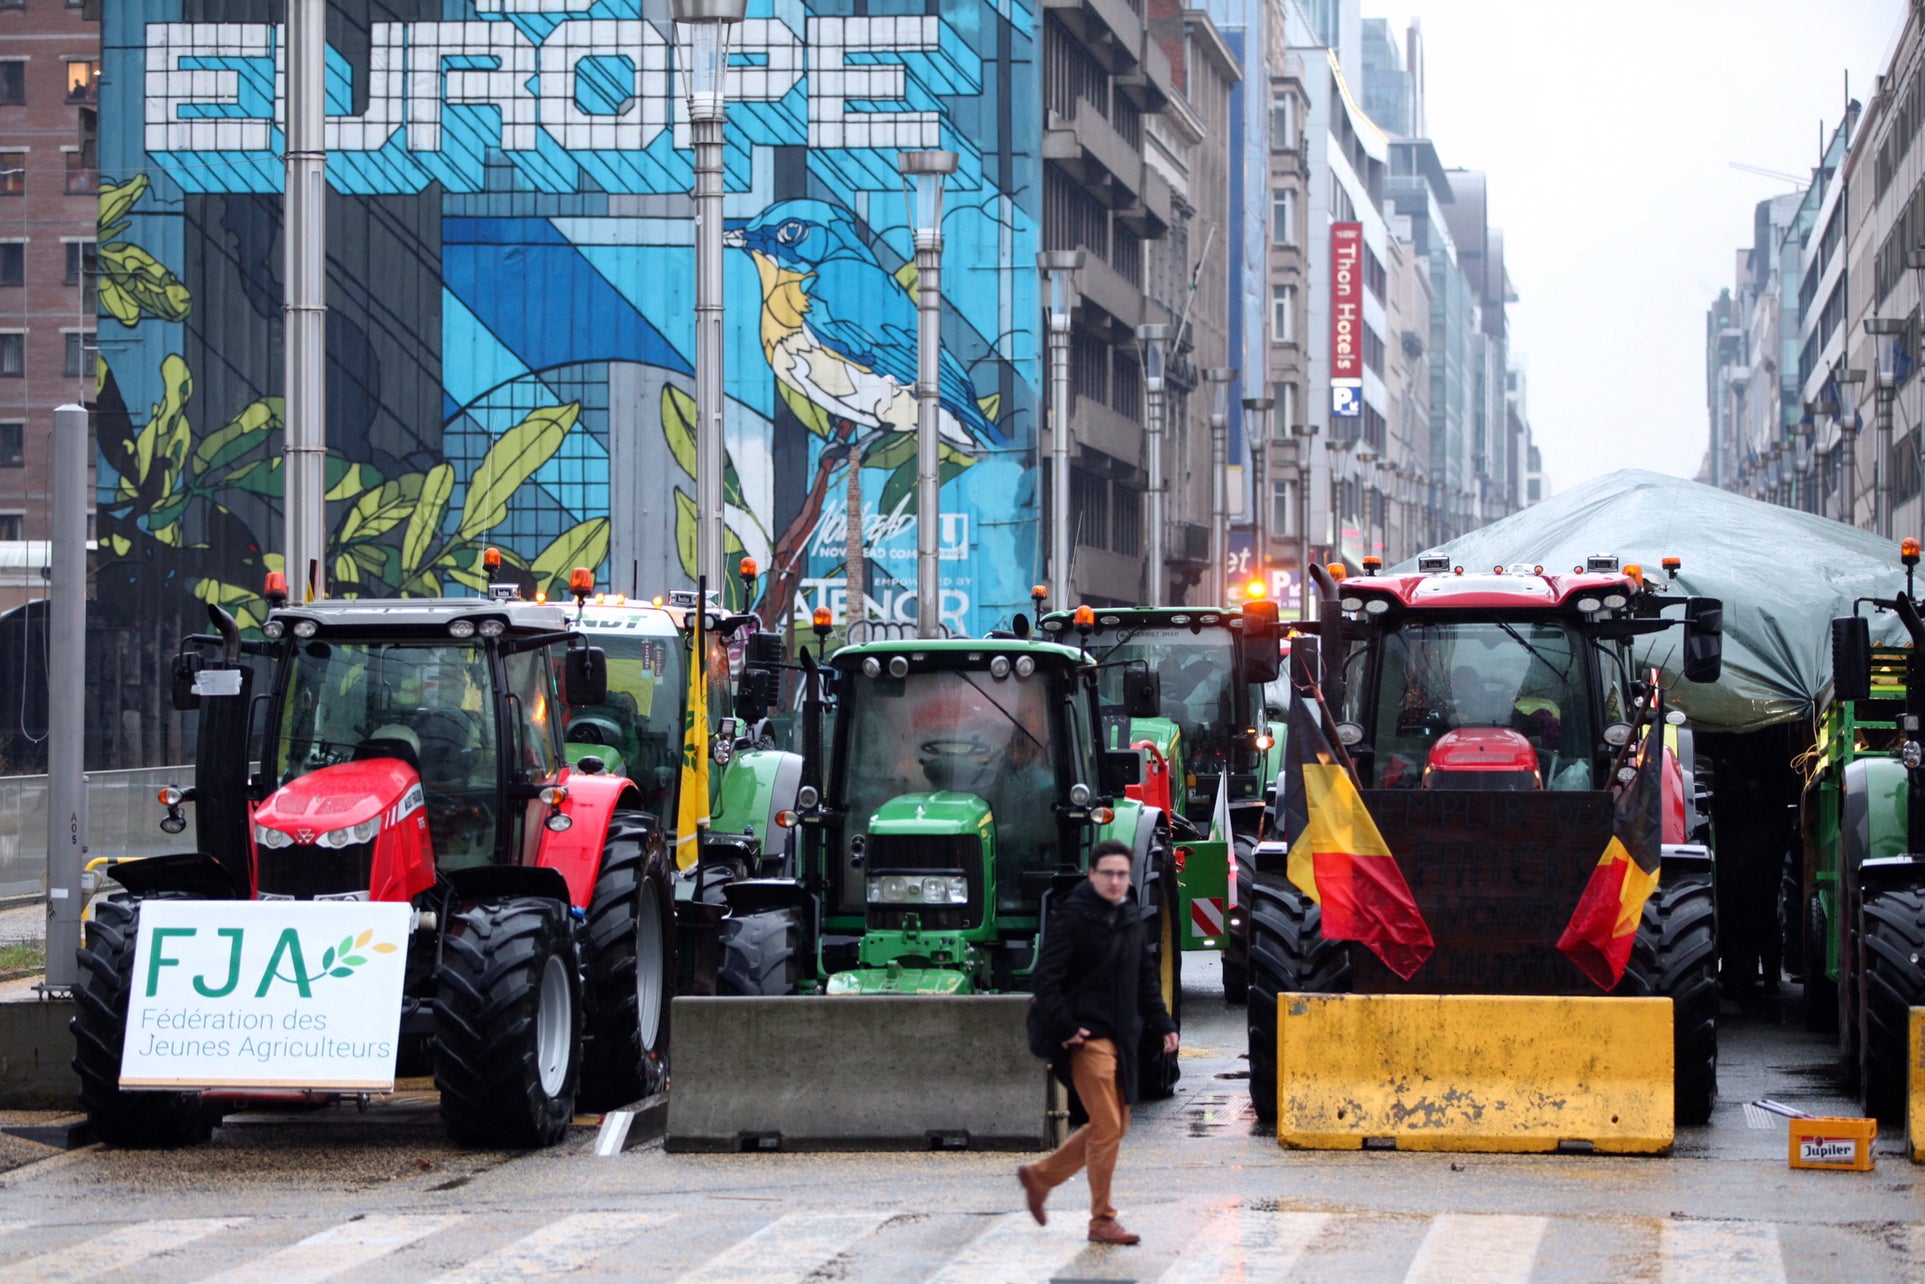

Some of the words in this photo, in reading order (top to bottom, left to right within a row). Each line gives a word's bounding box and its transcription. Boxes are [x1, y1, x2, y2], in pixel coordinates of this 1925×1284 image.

[146, 15, 940, 152] EUROPE
[1337, 243, 1357, 297] Thon
[1337, 303, 1357, 370] Hotels
[145, 927, 312, 998] FJA
[141, 1008, 273, 1031] Fédération
[282, 1008, 327, 1031] des
[138, 1035, 231, 1057] Jeunes
[237, 1035, 391, 1063] Agriculteurs
[1804, 1144, 1851, 1158] Jupiler
